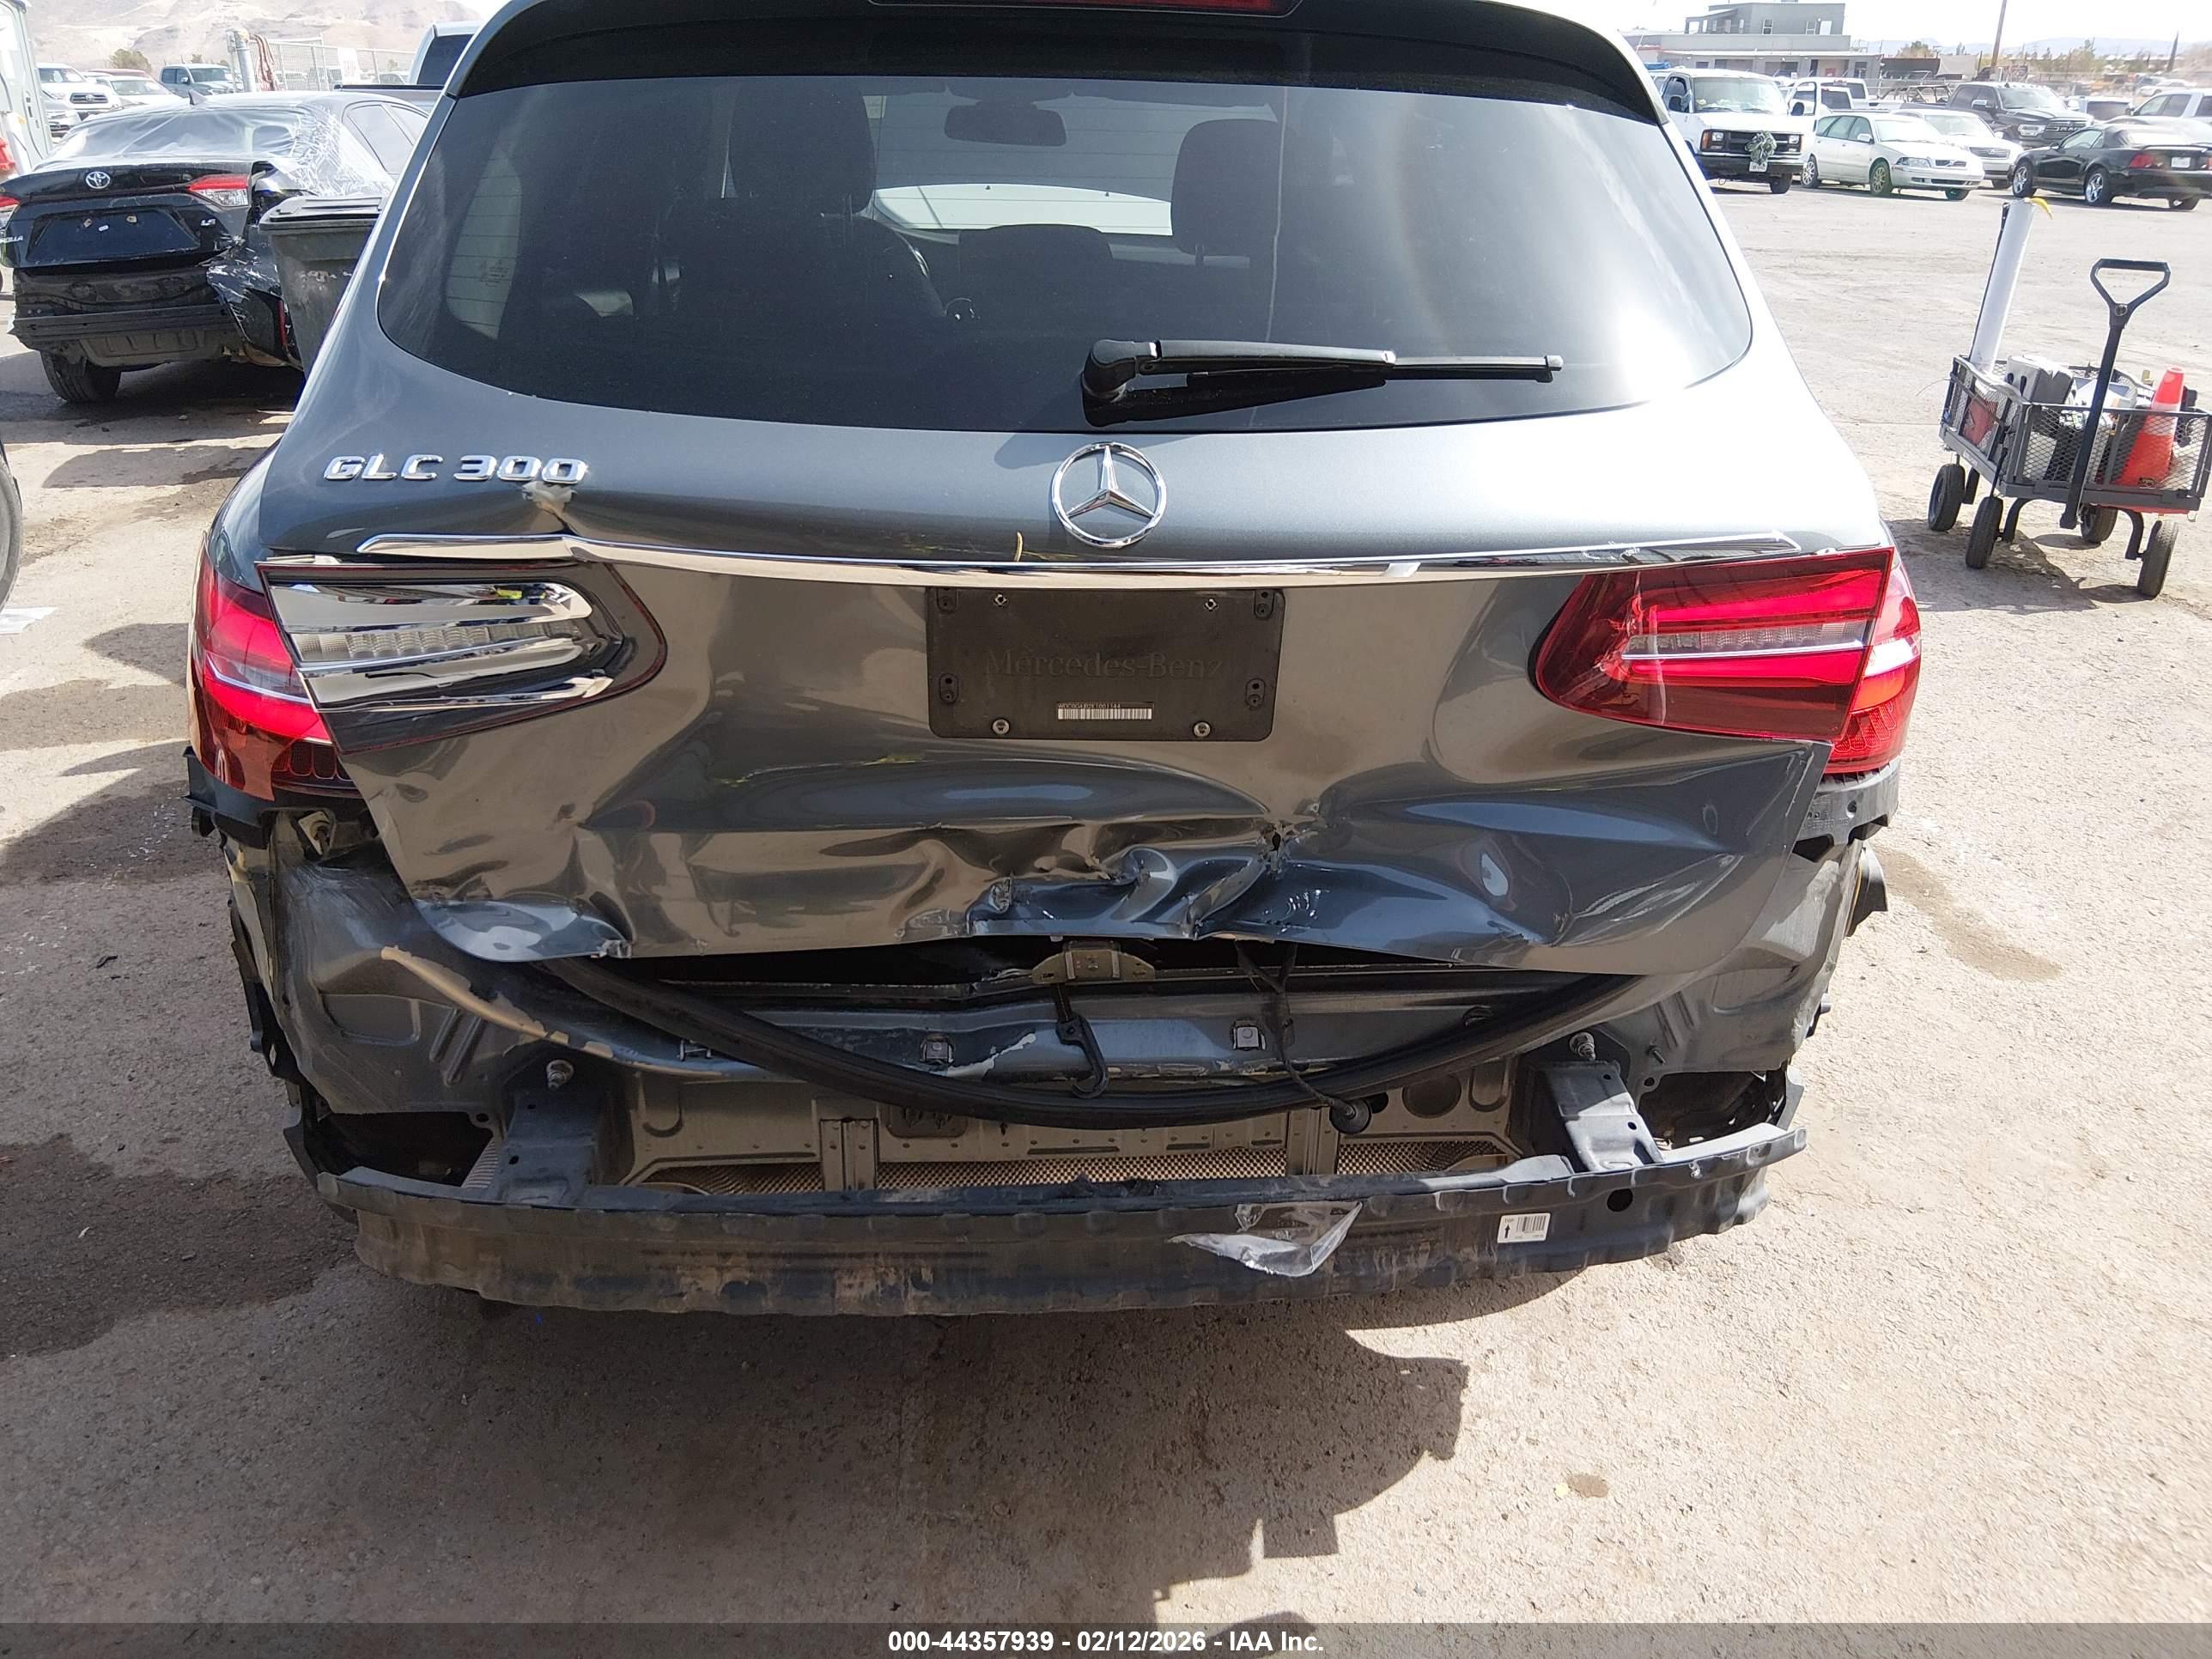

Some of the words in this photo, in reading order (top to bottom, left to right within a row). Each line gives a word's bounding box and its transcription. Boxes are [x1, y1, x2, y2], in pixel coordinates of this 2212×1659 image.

[324, 454, 443, 481] GLC
[453, 454, 587, 484] 300
[983, 650, 1223, 678] Mercedes-Benz
